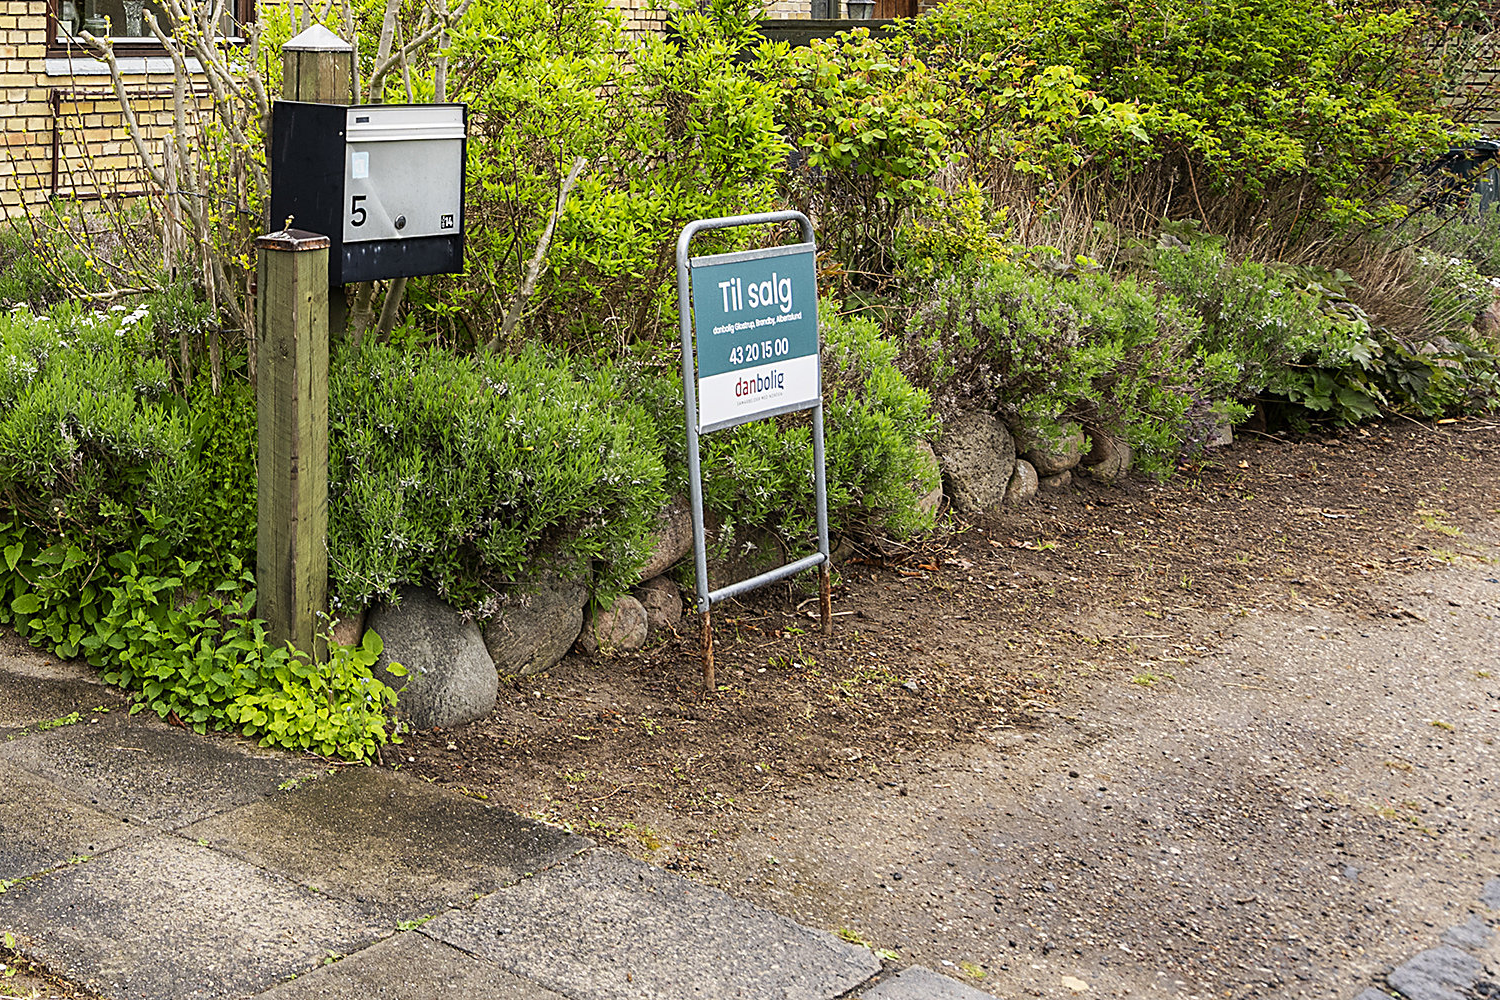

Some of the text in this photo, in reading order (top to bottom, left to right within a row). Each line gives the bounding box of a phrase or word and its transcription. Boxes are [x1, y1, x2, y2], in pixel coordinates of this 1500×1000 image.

[350, 194, 367, 227] 5
[718, 272, 793, 314] Til salg
[712, 323, 735, 335] danbolig
[729, 337, 789, 365] 43 20 15 00
[735, 369, 785, 398] danbolig
